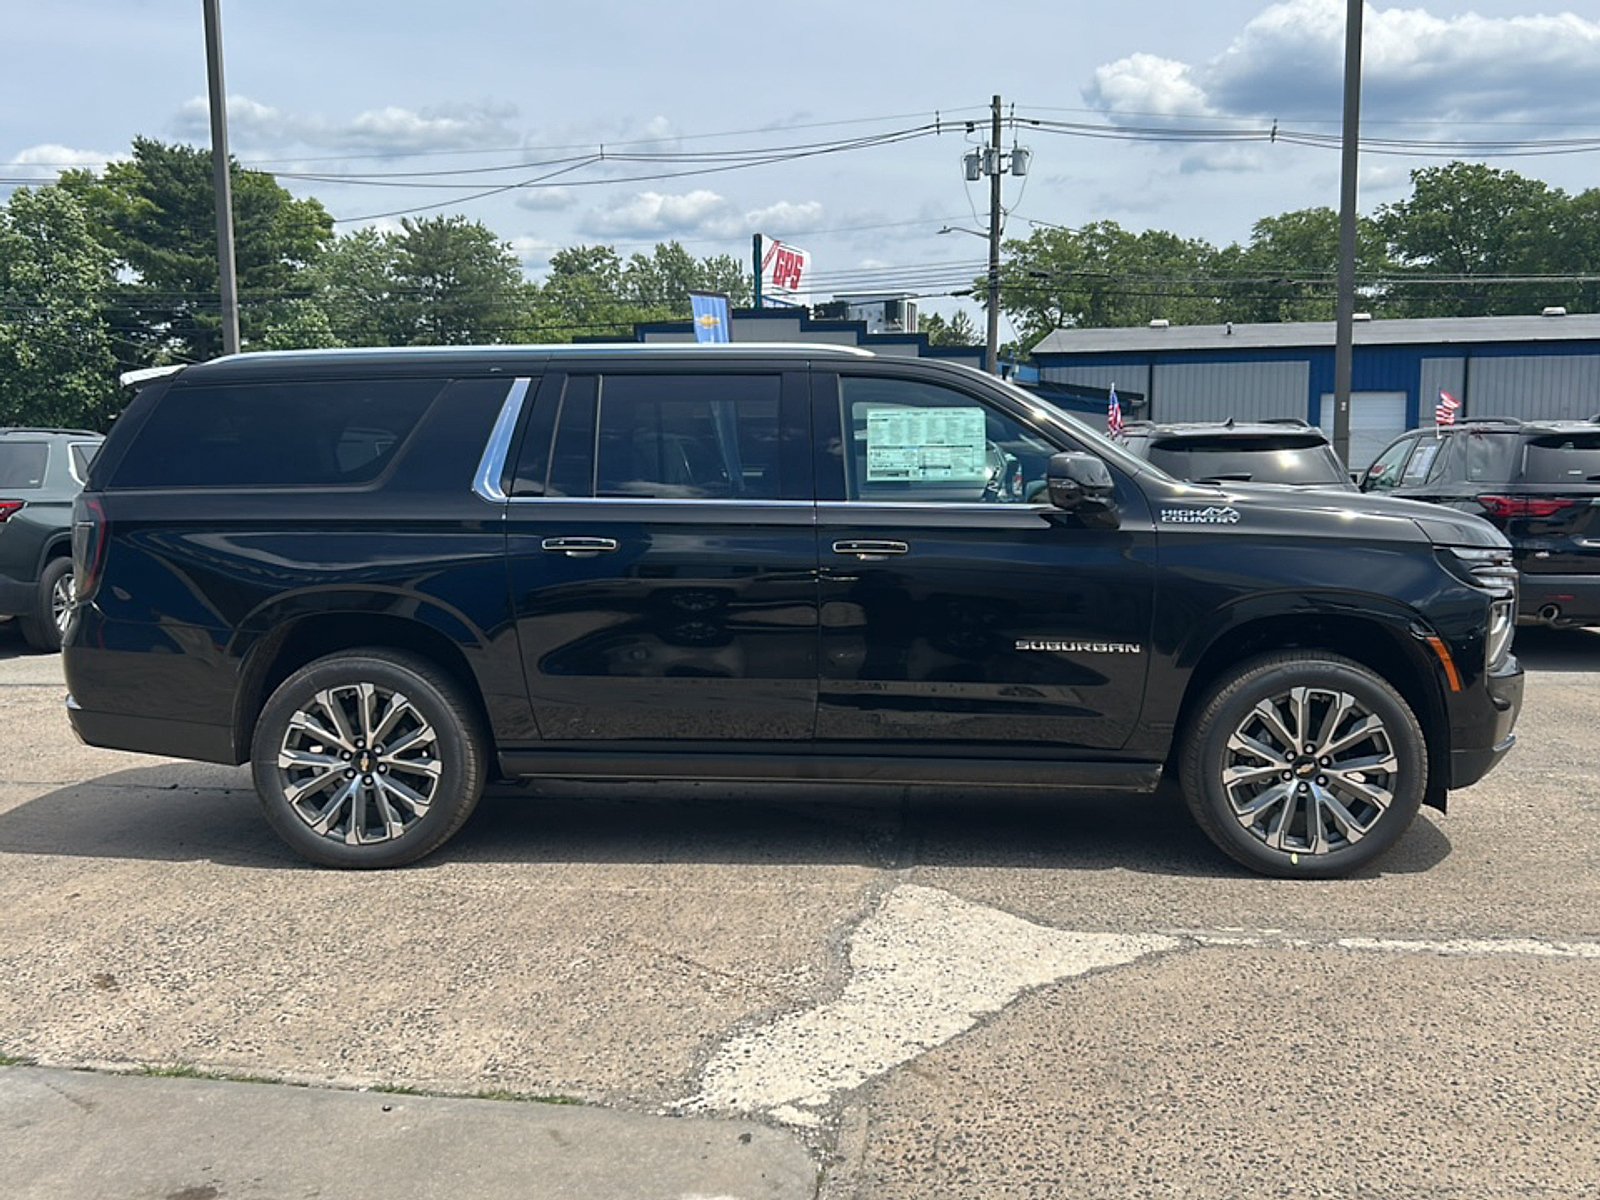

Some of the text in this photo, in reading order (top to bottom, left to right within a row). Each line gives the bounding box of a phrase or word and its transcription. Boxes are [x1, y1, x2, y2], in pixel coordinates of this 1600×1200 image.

[773, 248, 804, 289] GPS
[1161, 514, 1240, 523] COUNTRY
[1015, 640, 1140, 653] SUBURBAN
